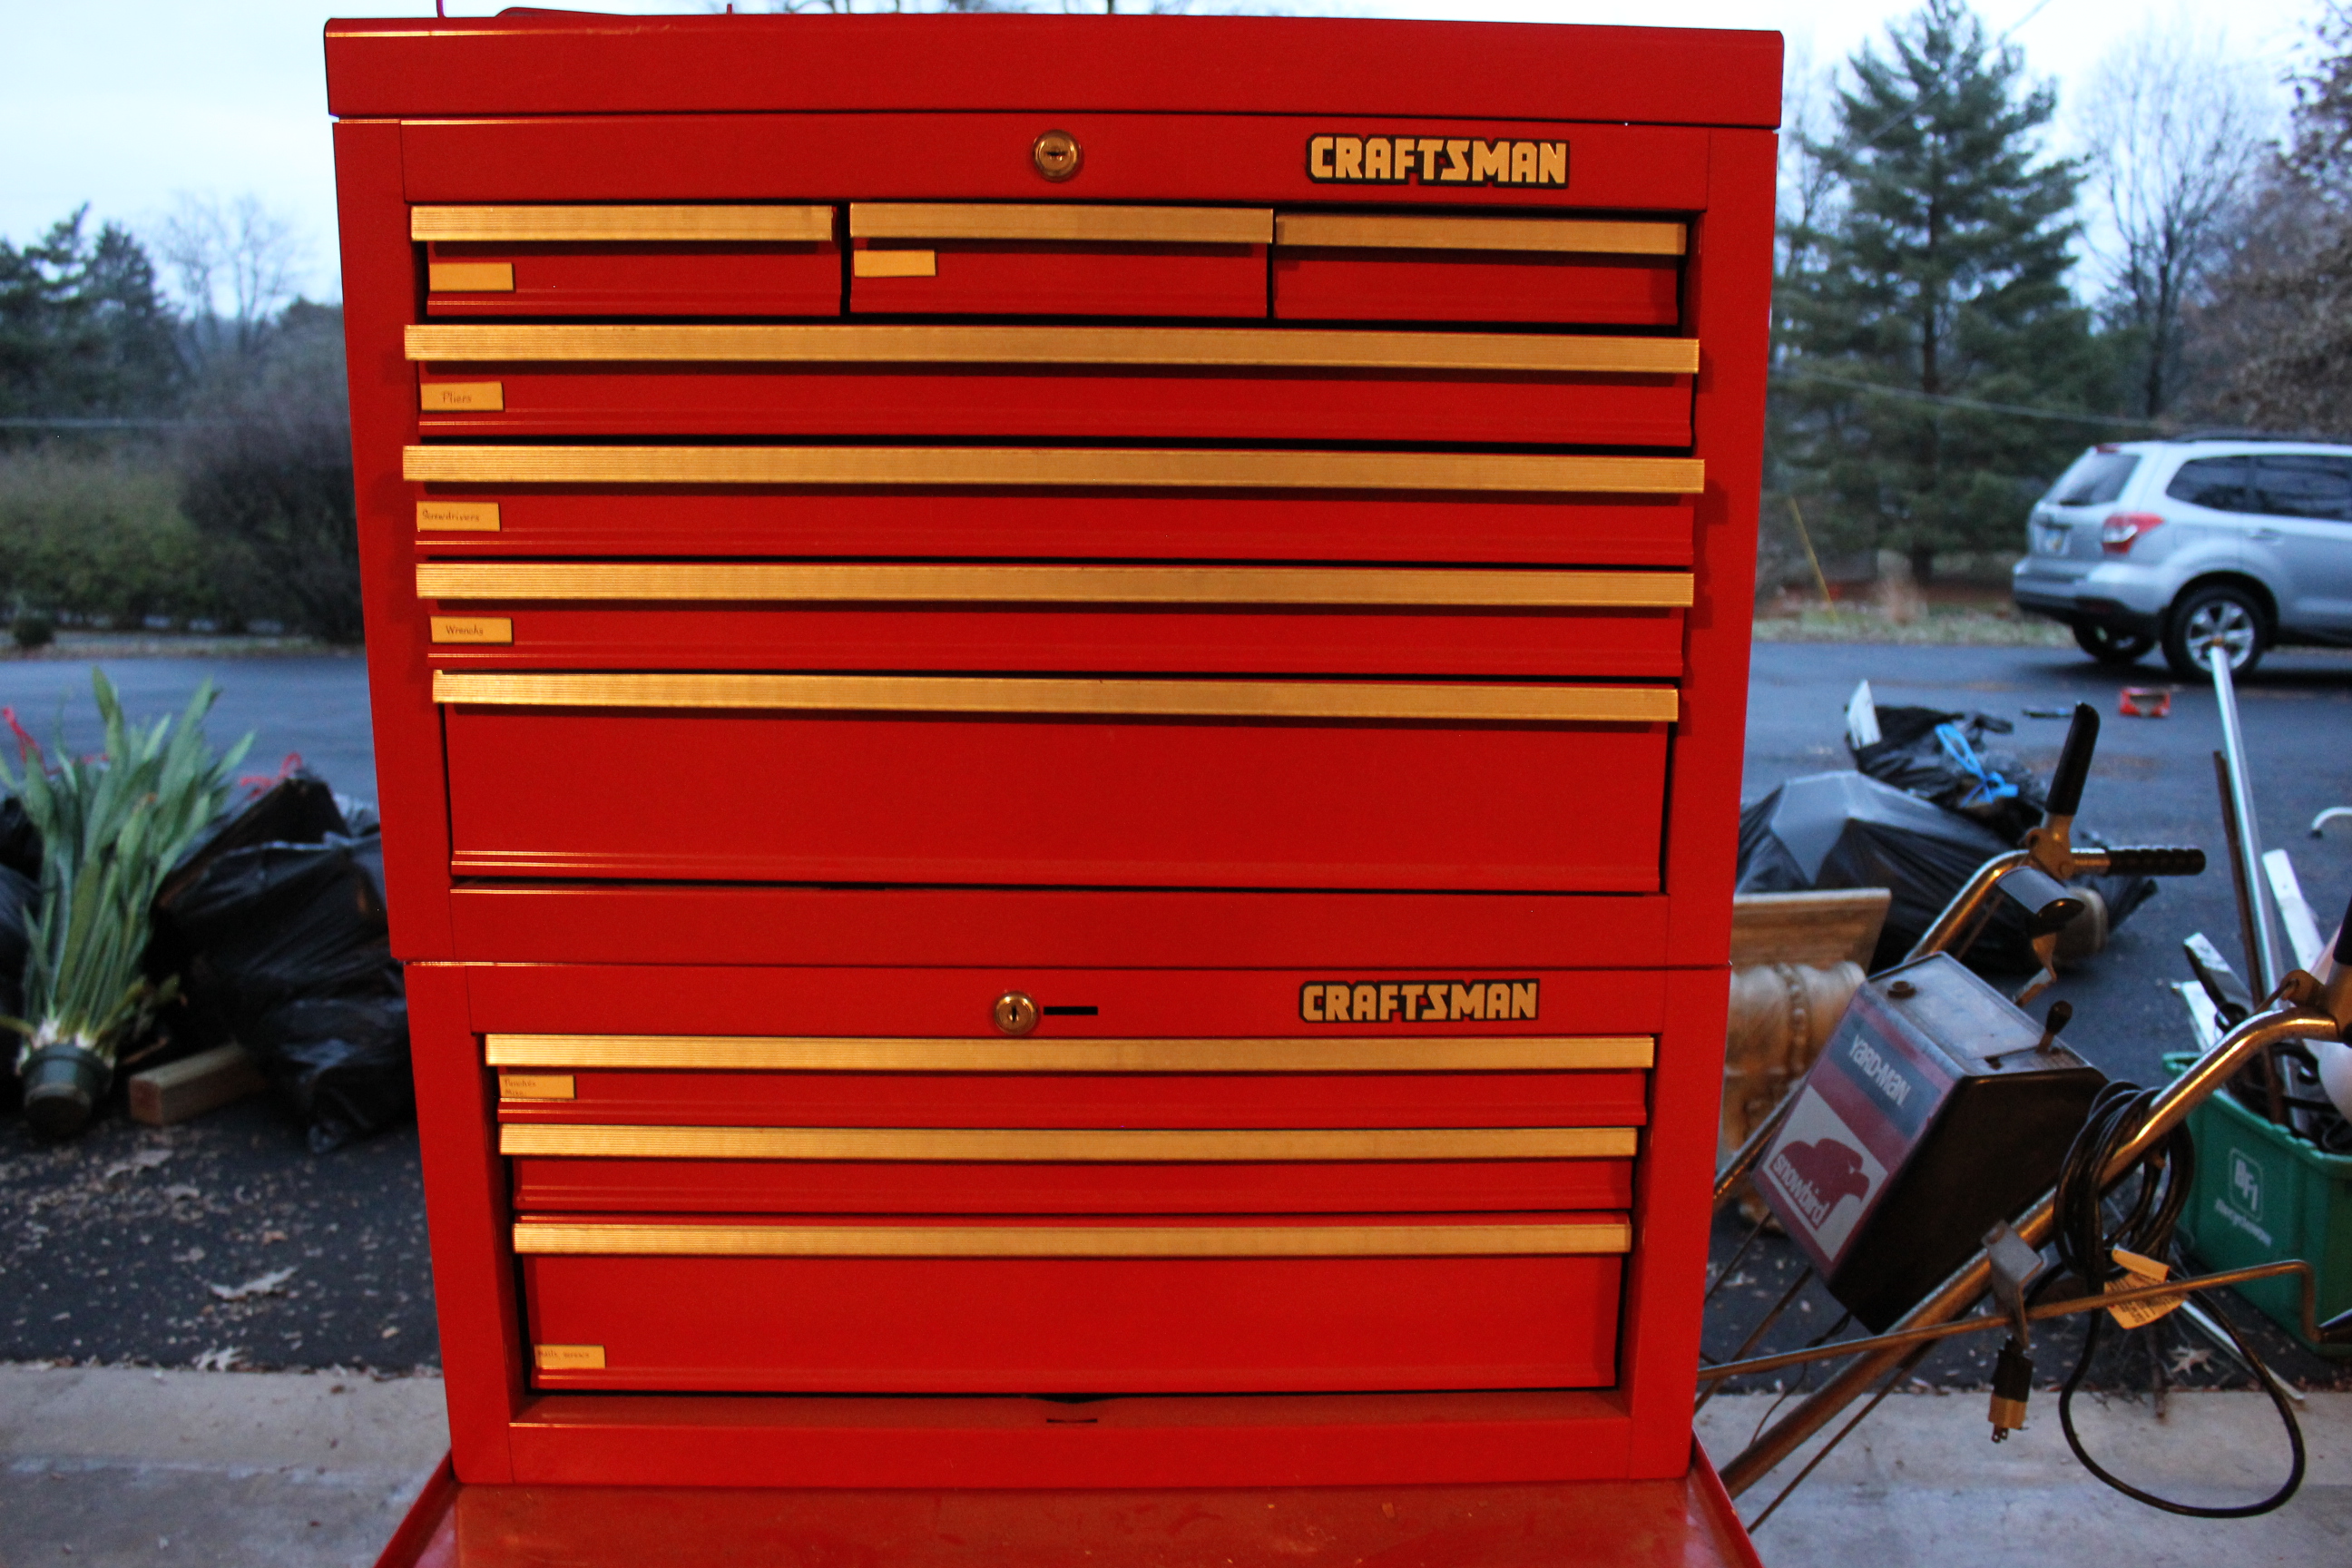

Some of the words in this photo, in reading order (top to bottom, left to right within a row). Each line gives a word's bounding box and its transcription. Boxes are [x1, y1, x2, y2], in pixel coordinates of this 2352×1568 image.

[1308, 134, 1568, 188] CRAFTSMAN
[442, 390, 472, 404] Pliers
[1300, 979, 1539, 1022] CRAFTSMAN
[1772, 1152, 1831, 1227] snowbird
